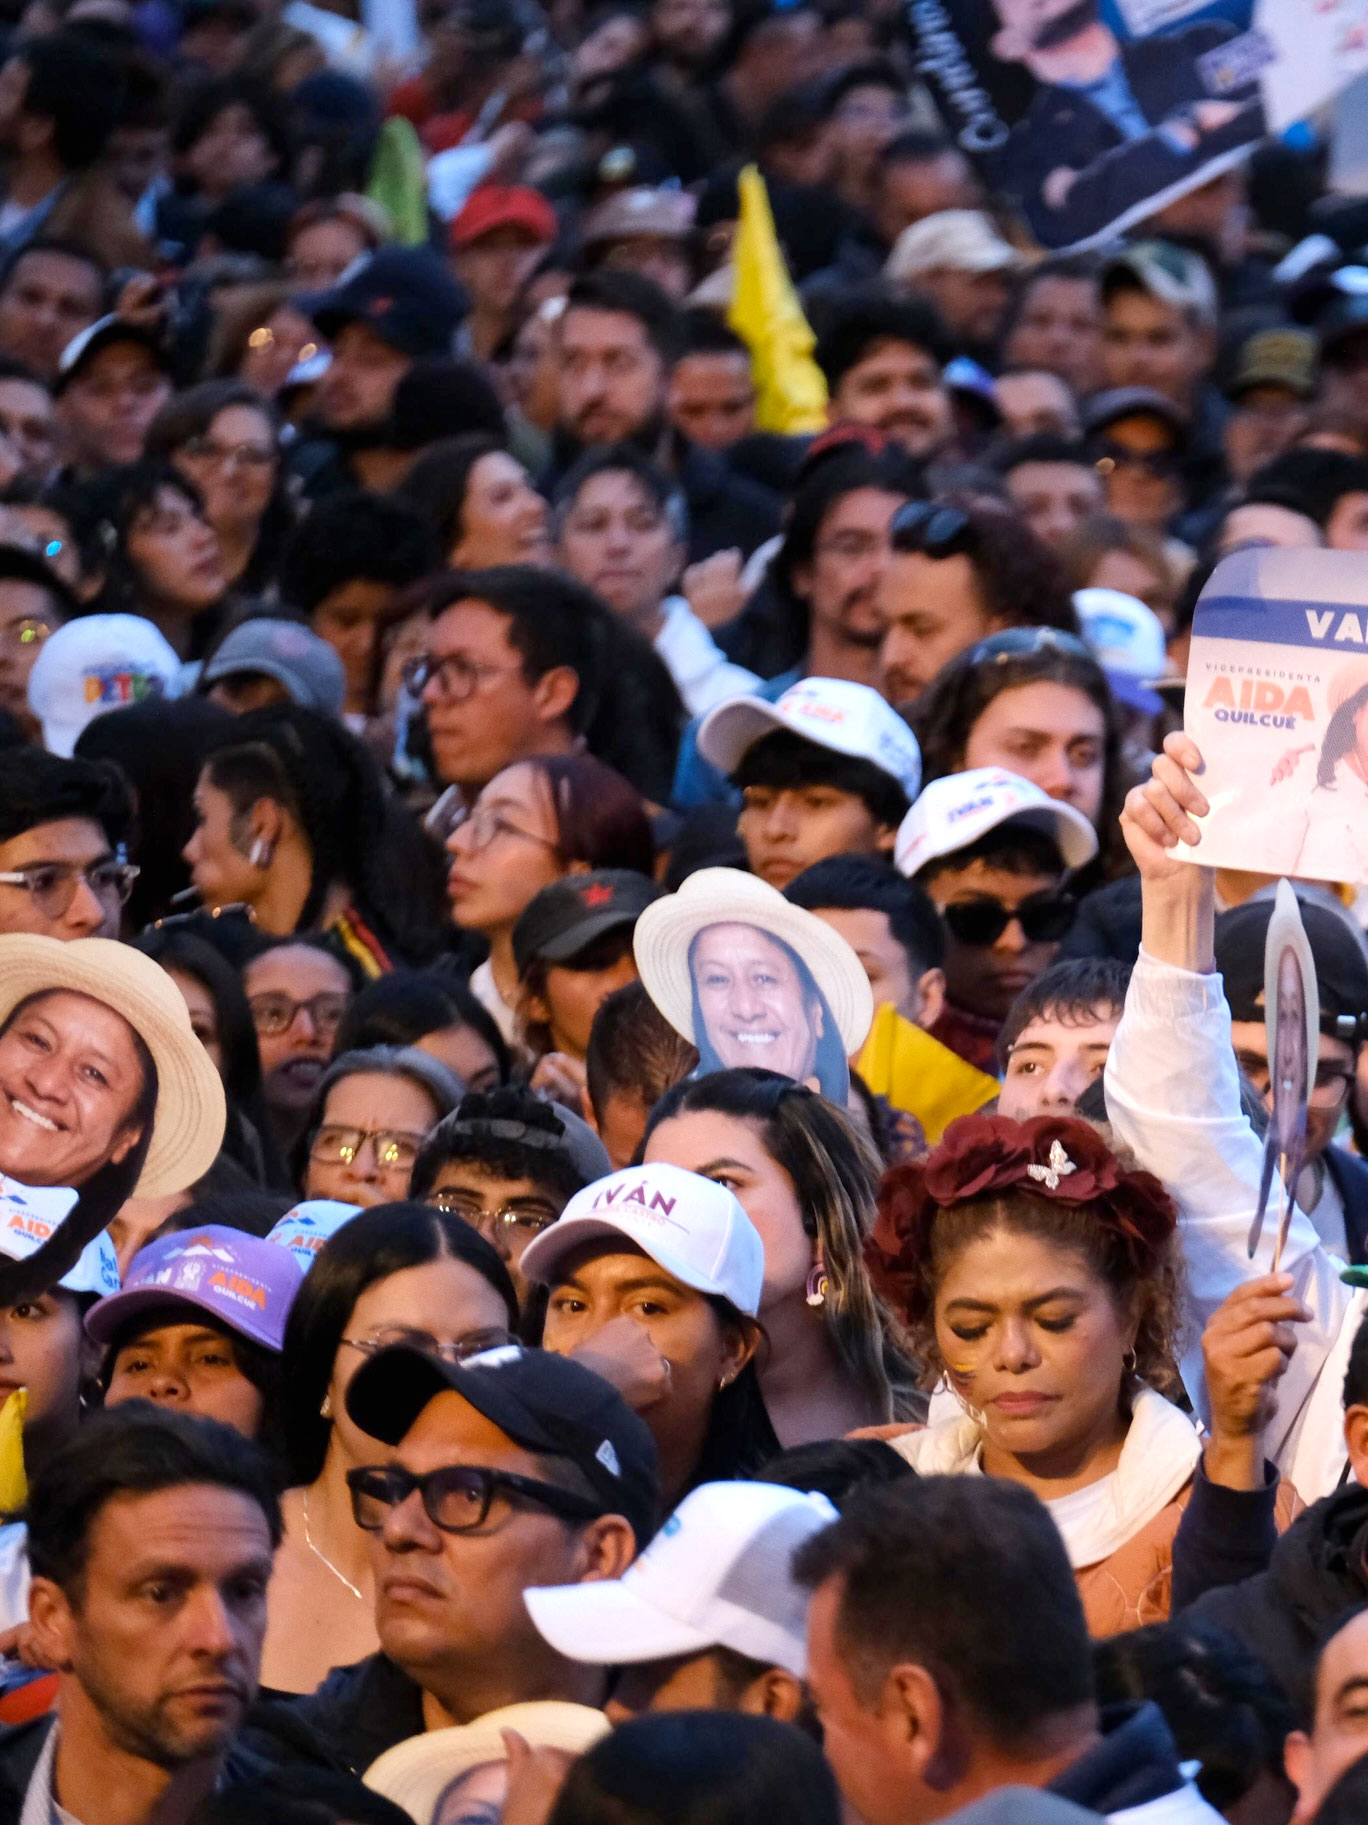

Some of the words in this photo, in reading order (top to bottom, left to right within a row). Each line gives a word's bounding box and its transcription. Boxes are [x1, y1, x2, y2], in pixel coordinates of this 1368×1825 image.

[1204, 662, 1321, 683] VICEPRESIDENTA
[1202, 675, 1316, 721] AIDA
[591, 1180, 677, 1216] IVÁN
[208, 1271, 266, 1310] AIDA
